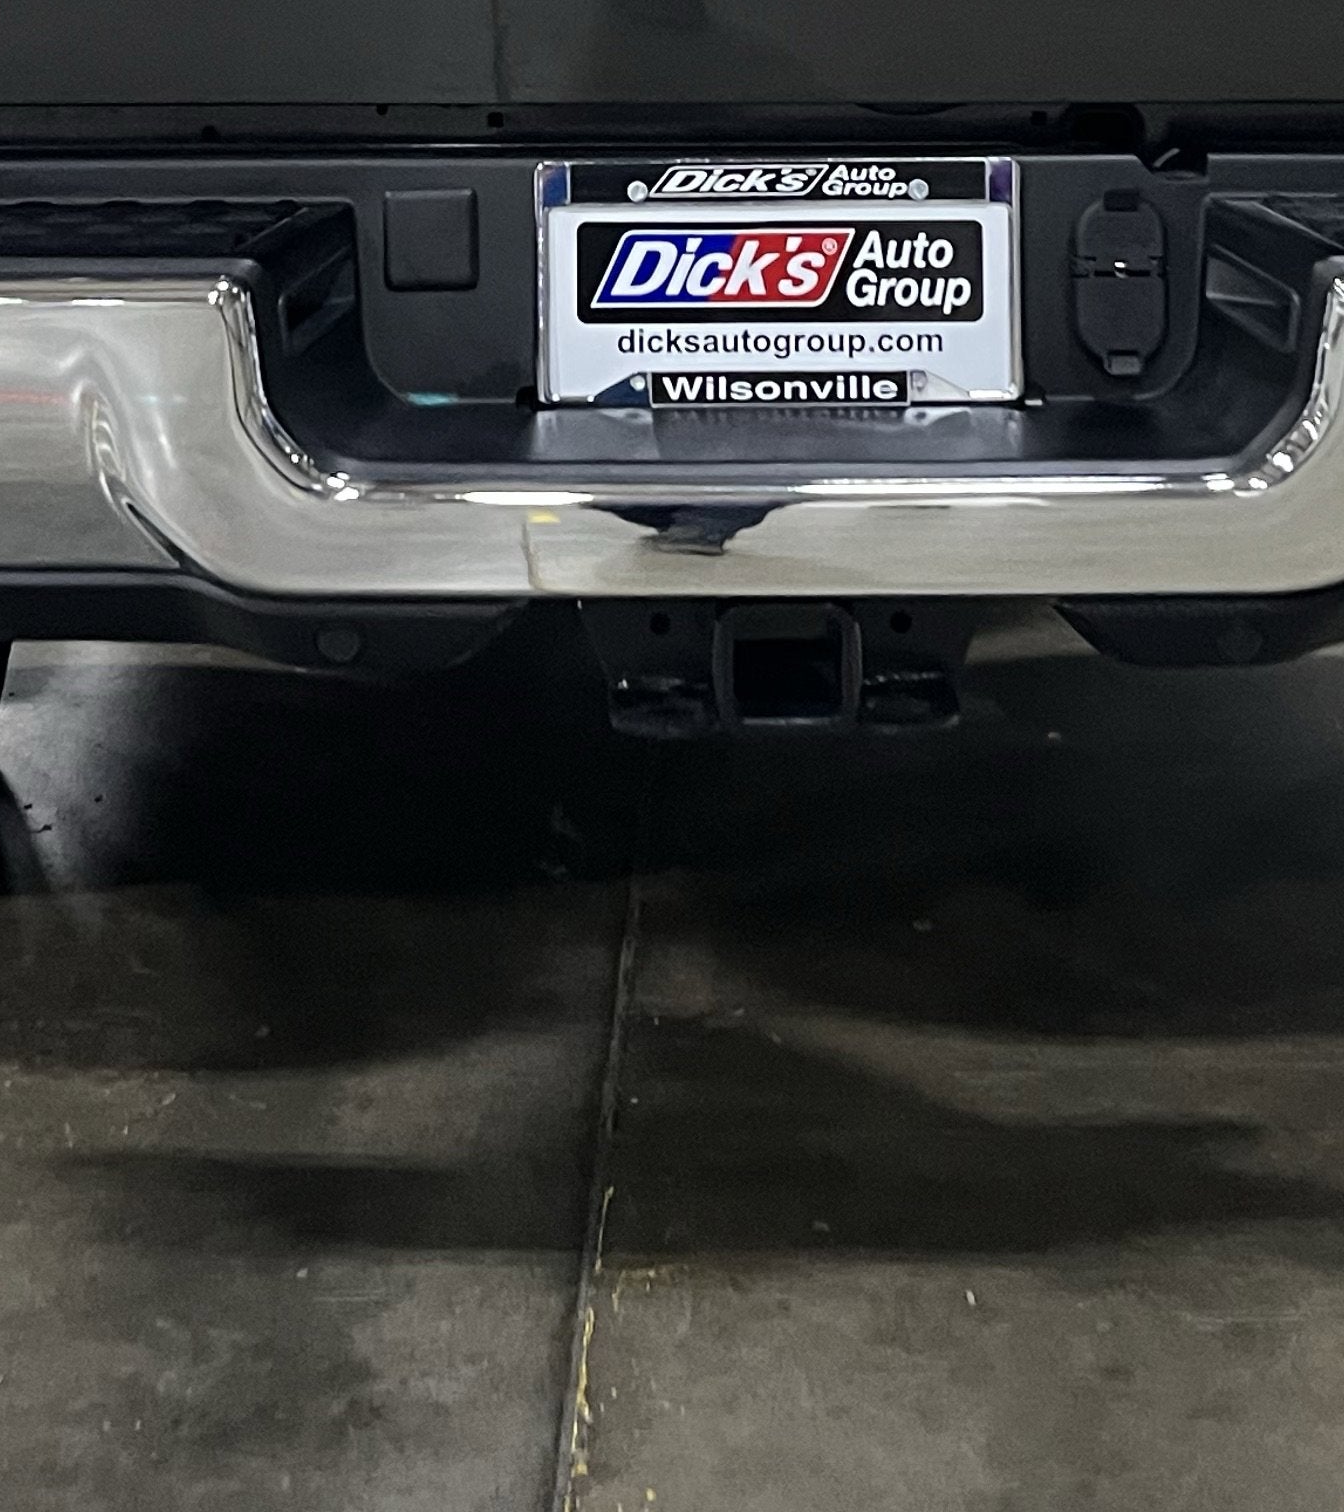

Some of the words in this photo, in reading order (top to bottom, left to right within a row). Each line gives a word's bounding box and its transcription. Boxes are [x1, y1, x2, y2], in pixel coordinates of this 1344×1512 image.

[661, 168, 809, 193] Dick's
[829, 164, 896, 181] Auto
[822, 180, 908, 199] Group
[852, 230, 954, 270] Auto
[610, 237, 826, 297] Dick's
[846, 269, 972, 315] Group
[617, 329, 944, 359] dicksautogroup.com
[661, 374, 899, 402] Wilsonville
